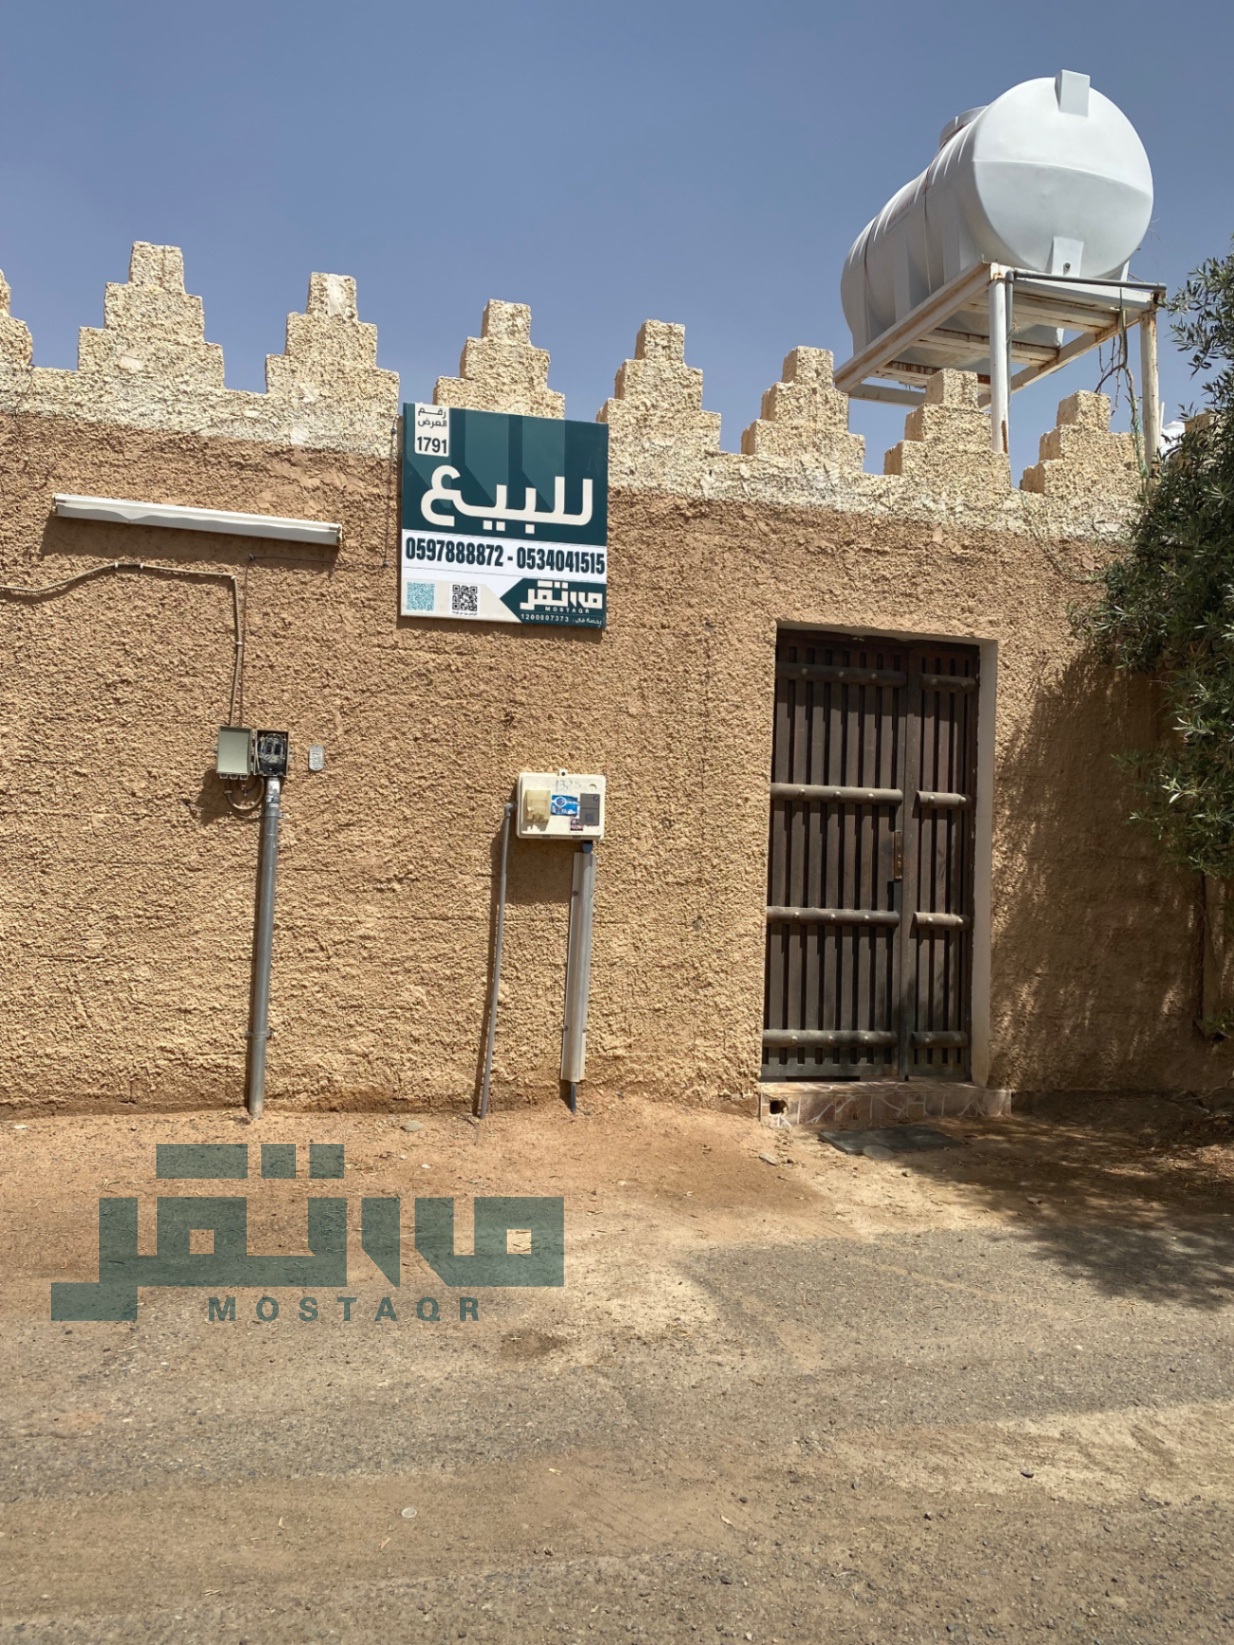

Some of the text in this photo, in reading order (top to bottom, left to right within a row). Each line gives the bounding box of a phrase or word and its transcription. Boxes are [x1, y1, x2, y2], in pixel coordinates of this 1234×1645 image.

[418, 407, 447, 419] رقم
[418, 418, 447, 429] العرض
[417, 436, 447, 454] 1791
[420, 464, 593, 534] للبيع
[405, 537, 504, 567] 0597888872
[516, 547, 605, 575] 0534041515
[544, 606, 590, 614] MOSTAQR
